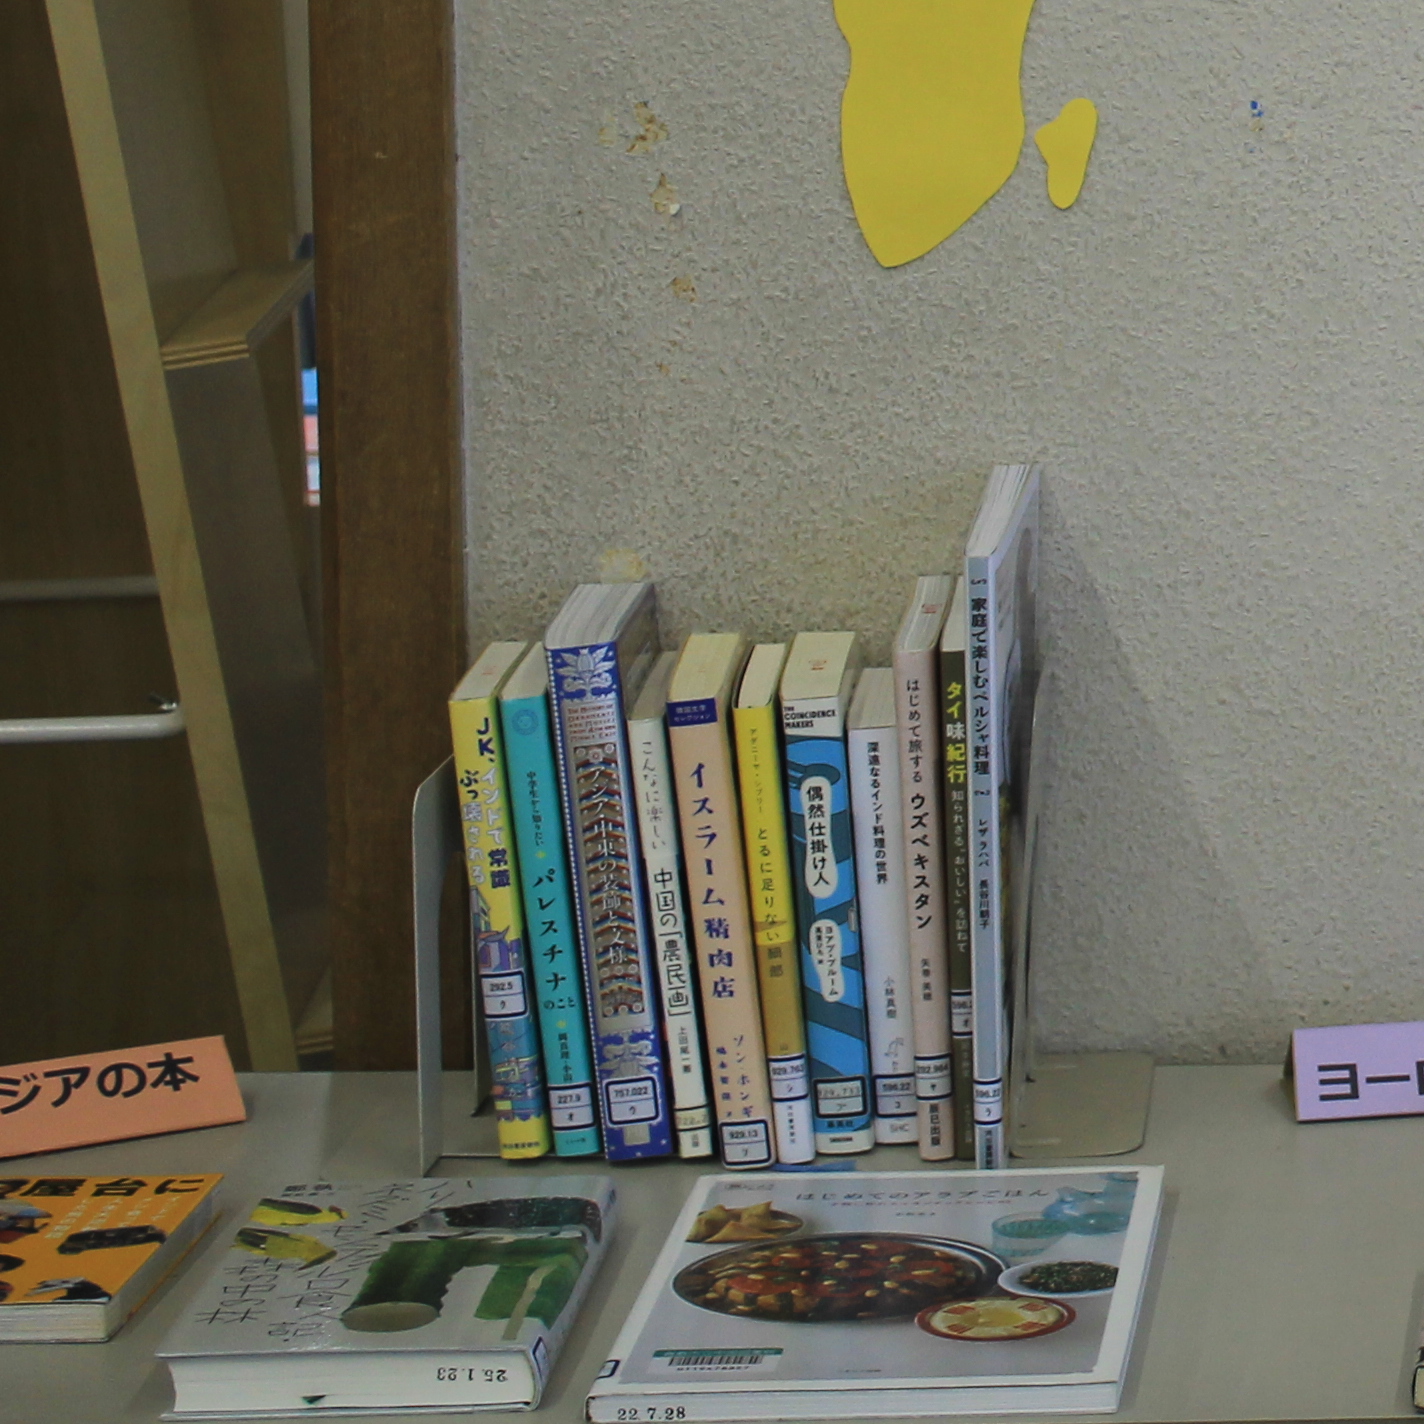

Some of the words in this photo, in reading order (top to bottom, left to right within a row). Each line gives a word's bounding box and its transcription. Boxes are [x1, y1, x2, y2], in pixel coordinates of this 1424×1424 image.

[784, 710, 836, 720] COINCIDENCE
[785, 720, 814, 728] MAKERS
[946, 681, 967, 784] タイ味紀行
[971, 597, 990, 775] 家庭で楽しむペルシャ料理
[642, 741, 666, 850] こんなに楽しい
[806, 786, 829, 887] 偶然仕掛け人
[867, 742, 888, 885] 深遠なるインド料理の世界
[690, 763, 736, 998] イスラーム精肉店
[796, 1188, 1050, 1202] はじめてのアラブごはん
